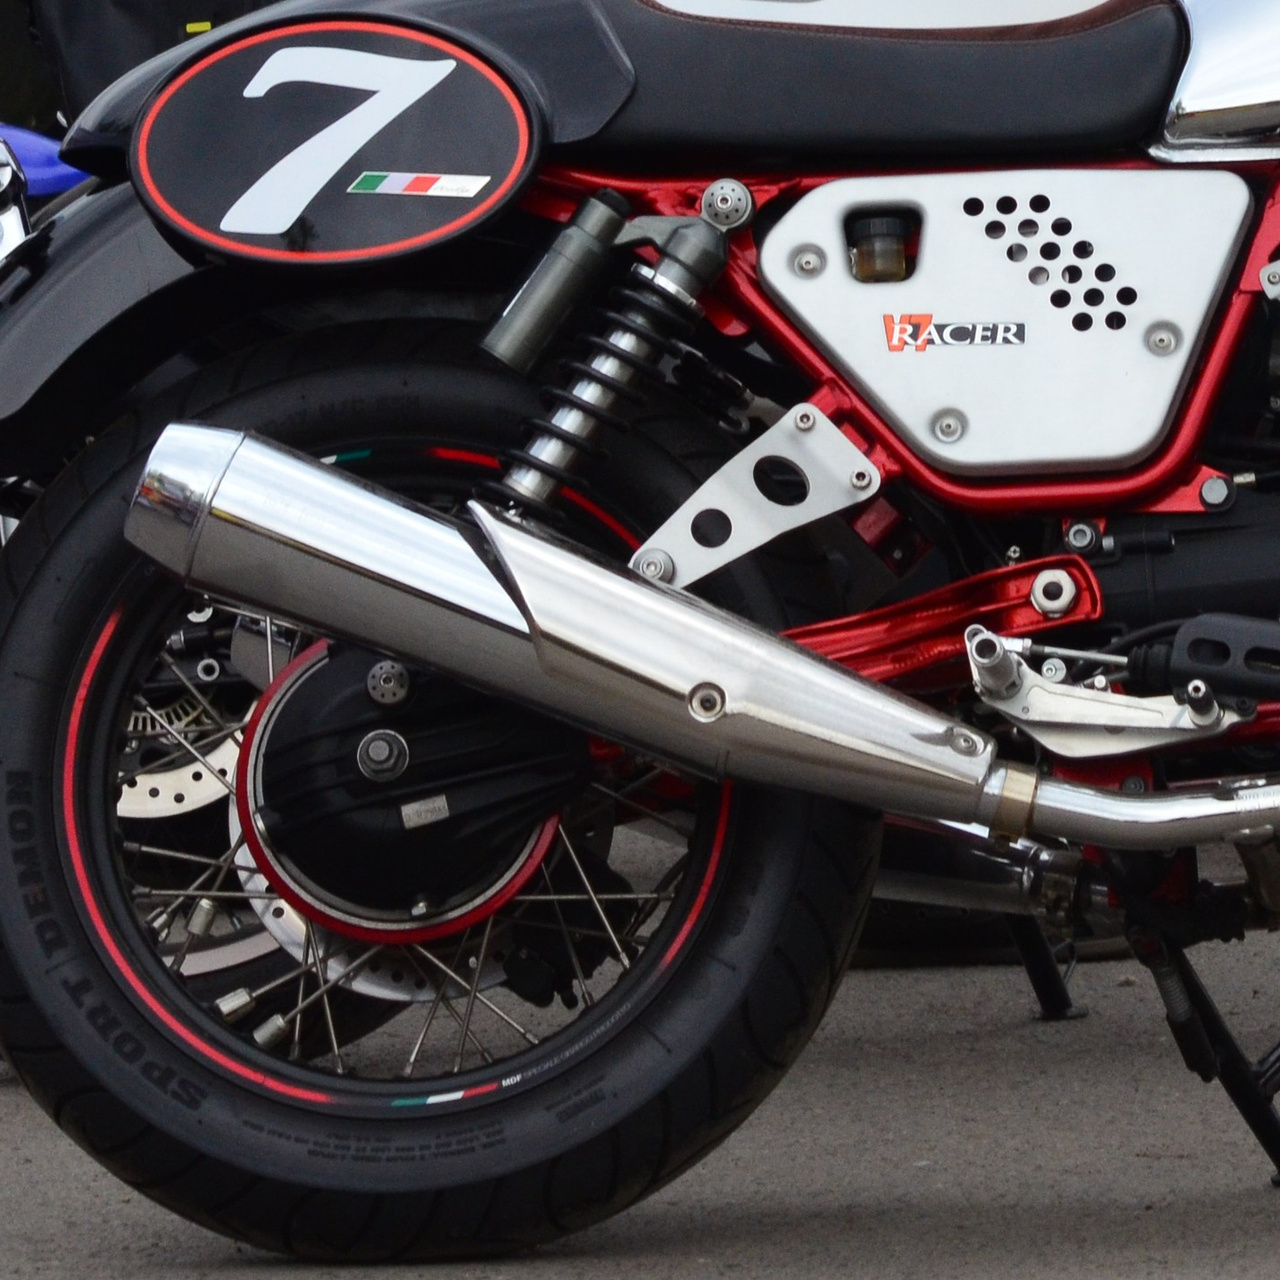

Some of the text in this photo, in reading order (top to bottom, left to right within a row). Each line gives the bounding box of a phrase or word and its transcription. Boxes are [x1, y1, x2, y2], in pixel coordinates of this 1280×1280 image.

[219, 45, 458, 235] 7
[883, 313, 1026, 352] V7 RACER
[6, 771, 208, 1111] SPORT DEMON
[502, 1073, 522, 1087] MDF
